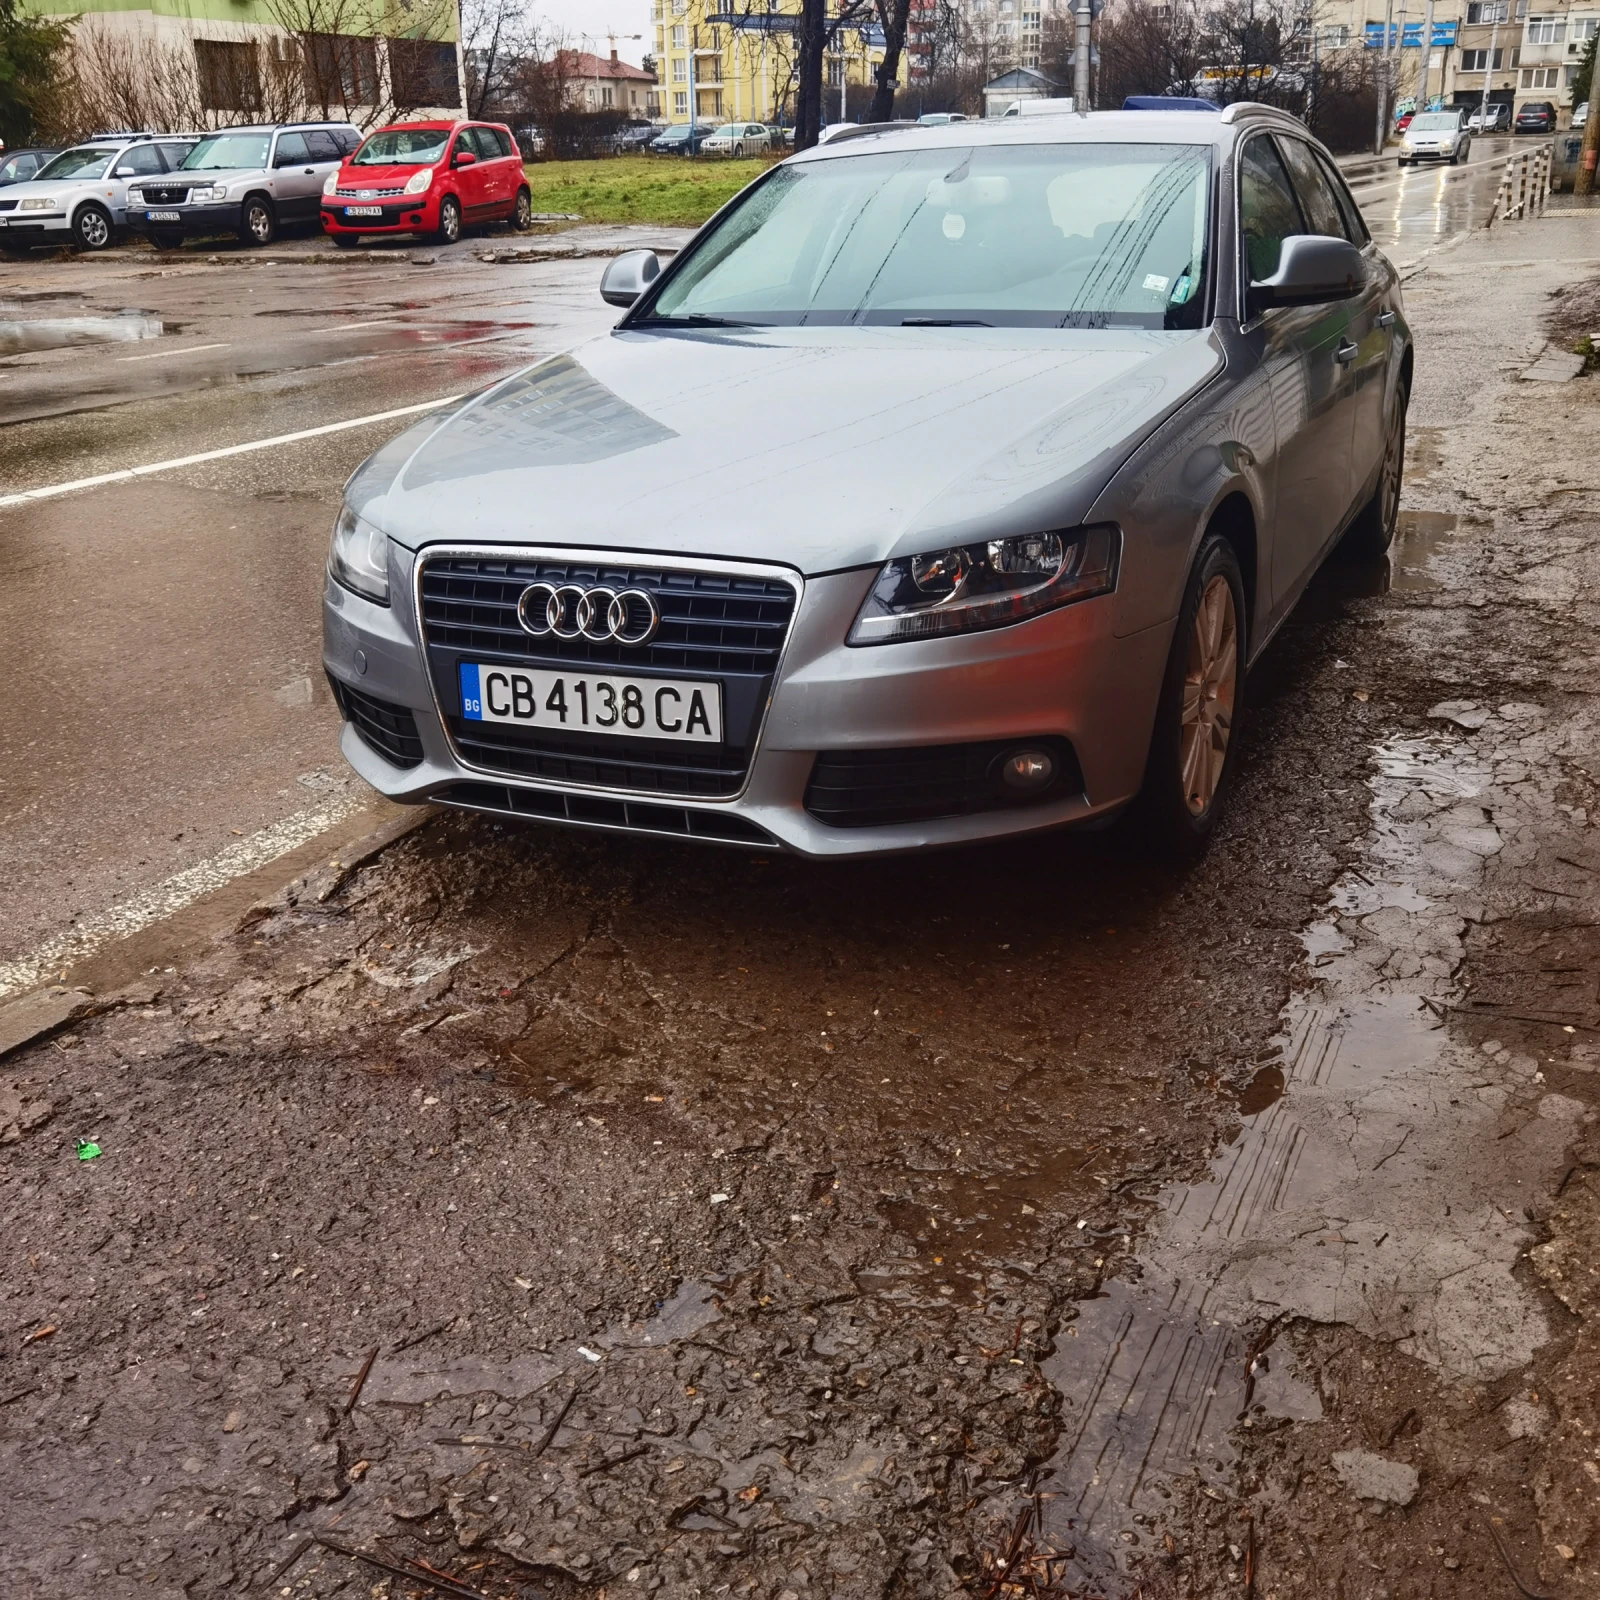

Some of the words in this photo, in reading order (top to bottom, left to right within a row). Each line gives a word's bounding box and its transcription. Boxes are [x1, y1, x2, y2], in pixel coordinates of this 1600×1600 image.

[465, 698, 480, 712] BG
[486, 672, 536, 719] CB
[545, 678, 646, 729] 4138
[654, 686, 712, 735] CA
